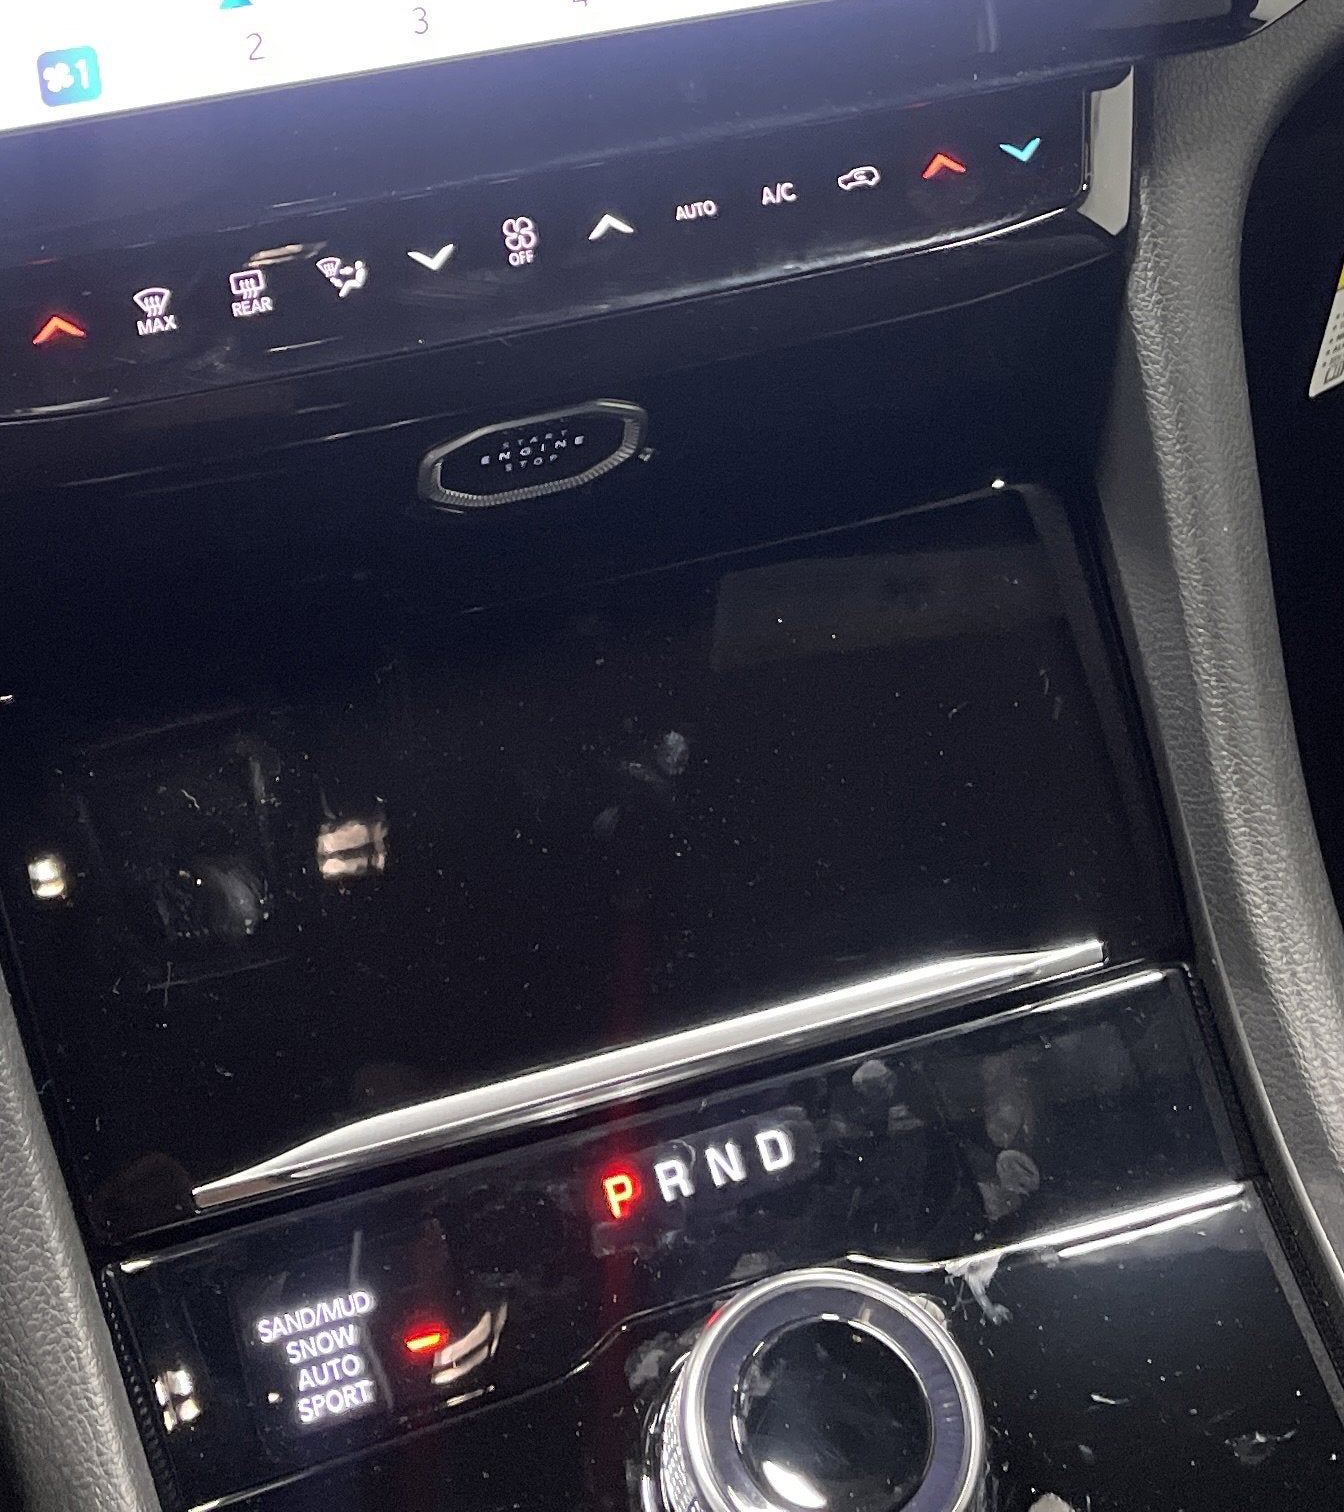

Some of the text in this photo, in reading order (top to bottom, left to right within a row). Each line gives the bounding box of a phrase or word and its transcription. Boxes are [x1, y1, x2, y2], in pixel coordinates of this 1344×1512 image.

[75, 60, 91, 90] 1
[248, 33, 267, 62] 2
[411, 7, 430, 35] 3
[761, 183, 797, 206] A/C
[675, 200, 718, 222] AUTO
[508, 251, 535, 266] OFF
[231, 296, 274, 318] REAR
[136, 314, 178, 336] MAX
[480, 435, 585, 466] ENGINE
[502, 429, 568, 450] START
[505, 453, 558, 473] STOP
[602, 1128, 795, 1220] P R N D
[258, 1291, 374, 1344] SAND/MUD
[286, 1324, 358, 1364] SNOW
[297, 1354, 362, 1394] AUTO
[298, 1381, 375, 1426] SPORT
